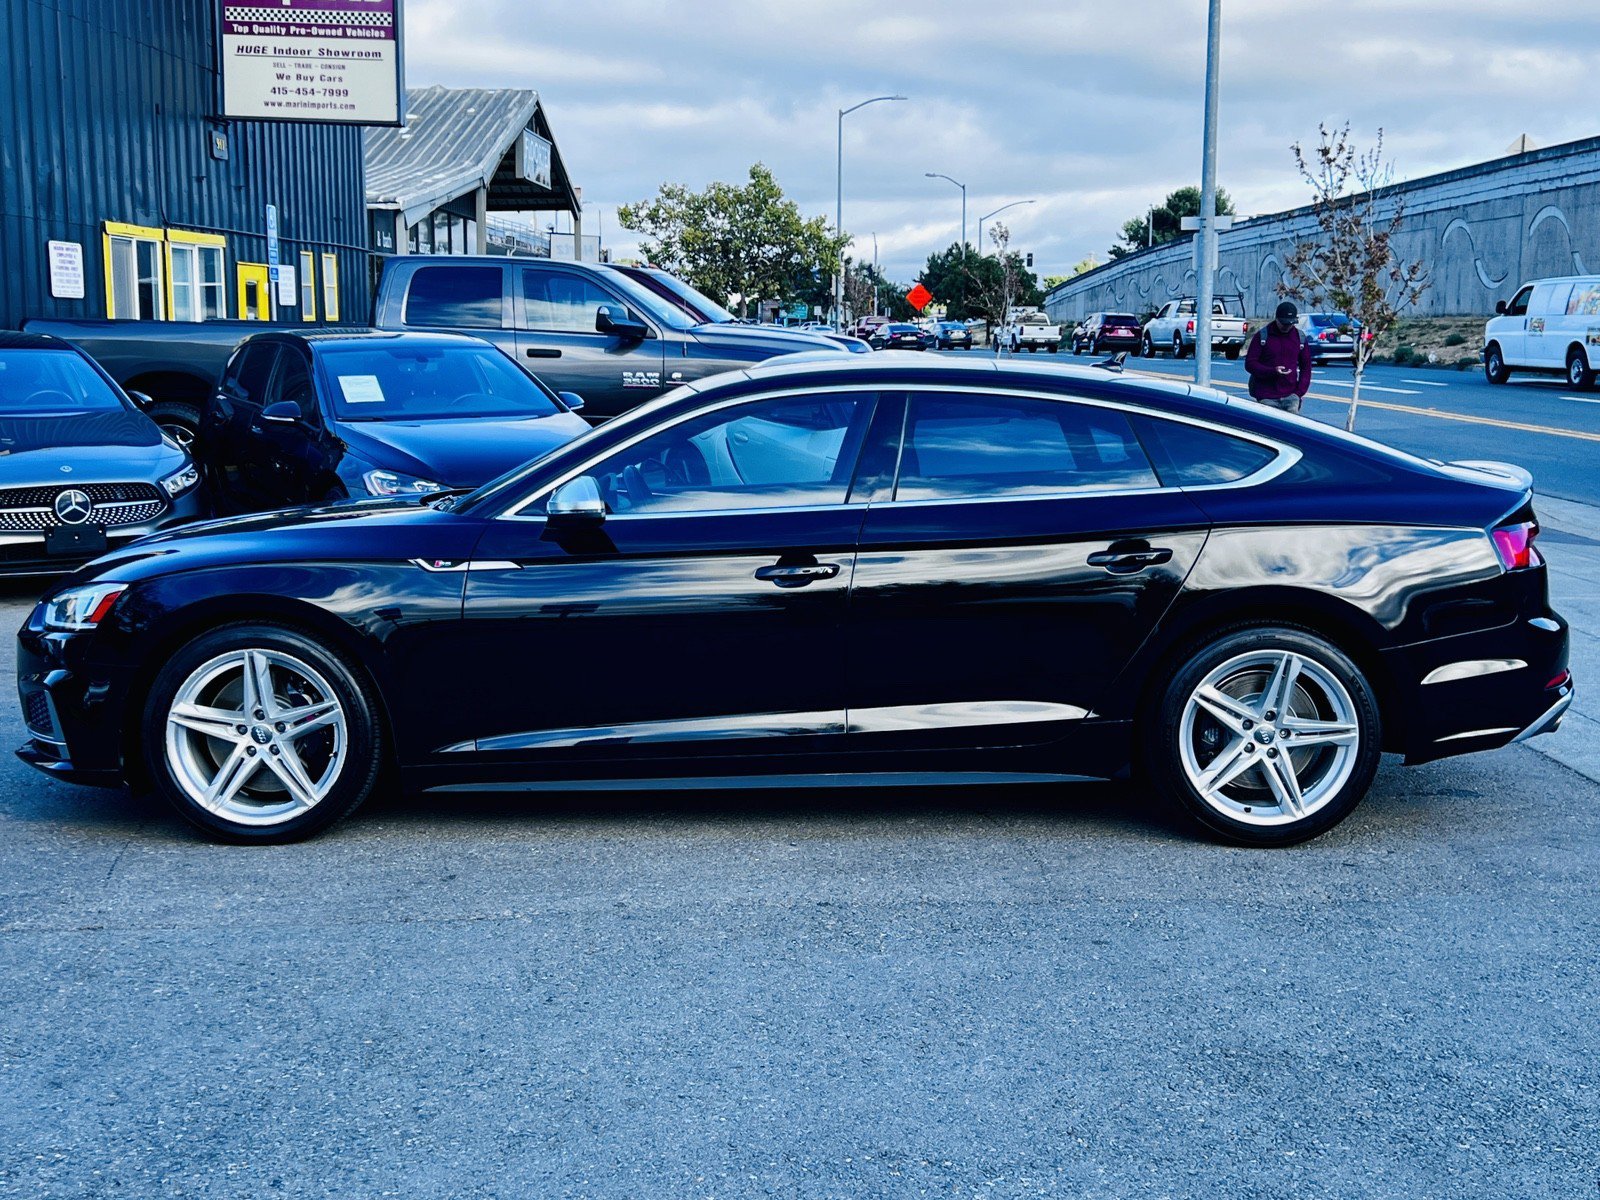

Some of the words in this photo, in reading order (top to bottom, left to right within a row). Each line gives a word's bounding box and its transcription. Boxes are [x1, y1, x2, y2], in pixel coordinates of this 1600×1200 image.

[232, 24, 249, 34] Top
[253, 24, 287, 35] Quality
[290, 25, 343, 36] Pre-Owned
[346, 28, 386, 38] Vehicles
[236, 45, 269, 54] HUGE
[273, 46, 312, 56] Indoor
[318, 48, 382, 58] Showroom
[276, 72, 291, 81] We
[296, 73, 315, 83] Buy
[319, 74, 343, 82] Cars
[270, 86, 349, 97] 415-454-7999
[263, 100, 356, 110] www.marinimports.com
